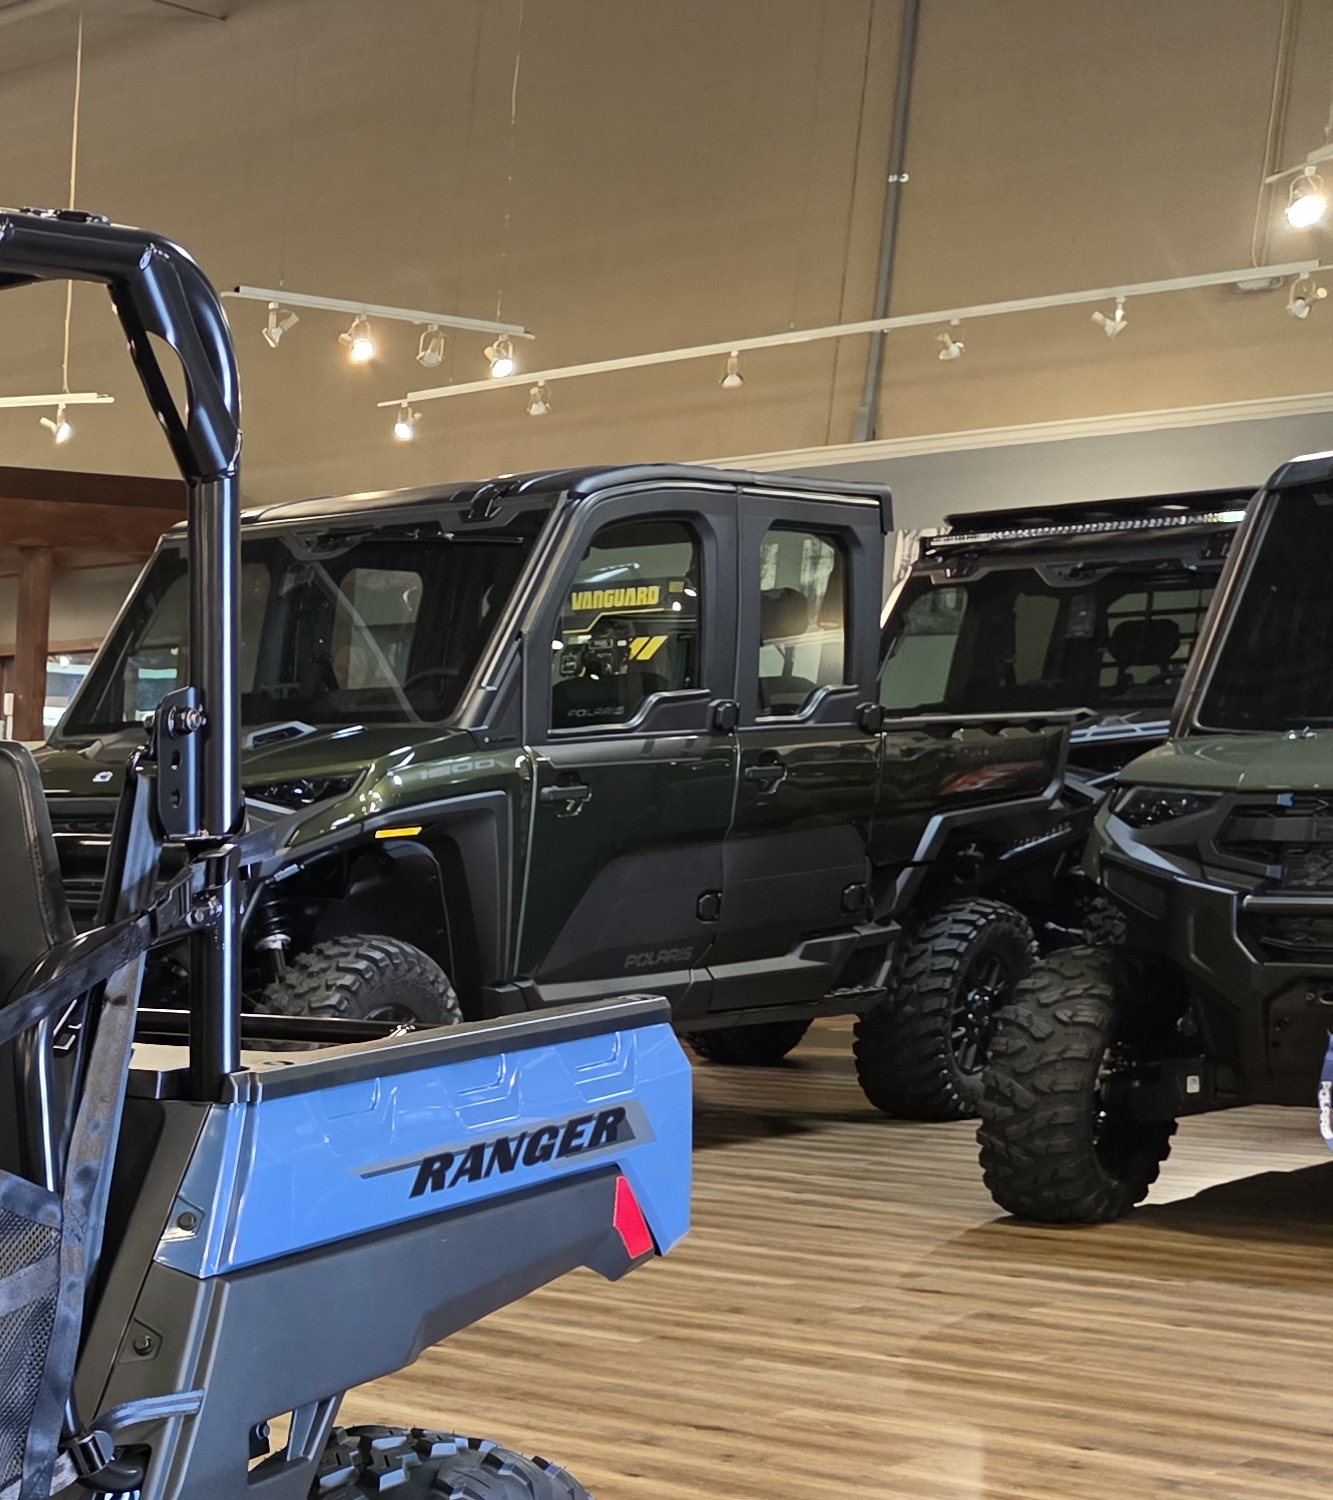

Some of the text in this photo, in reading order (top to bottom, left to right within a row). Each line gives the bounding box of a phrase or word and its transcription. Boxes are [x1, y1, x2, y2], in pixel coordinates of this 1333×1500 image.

[571, 585, 660, 611] VANGUARD
[624, 945, 694, 970] POLARIS
[408, 1106, 627, 1200] RANGER
